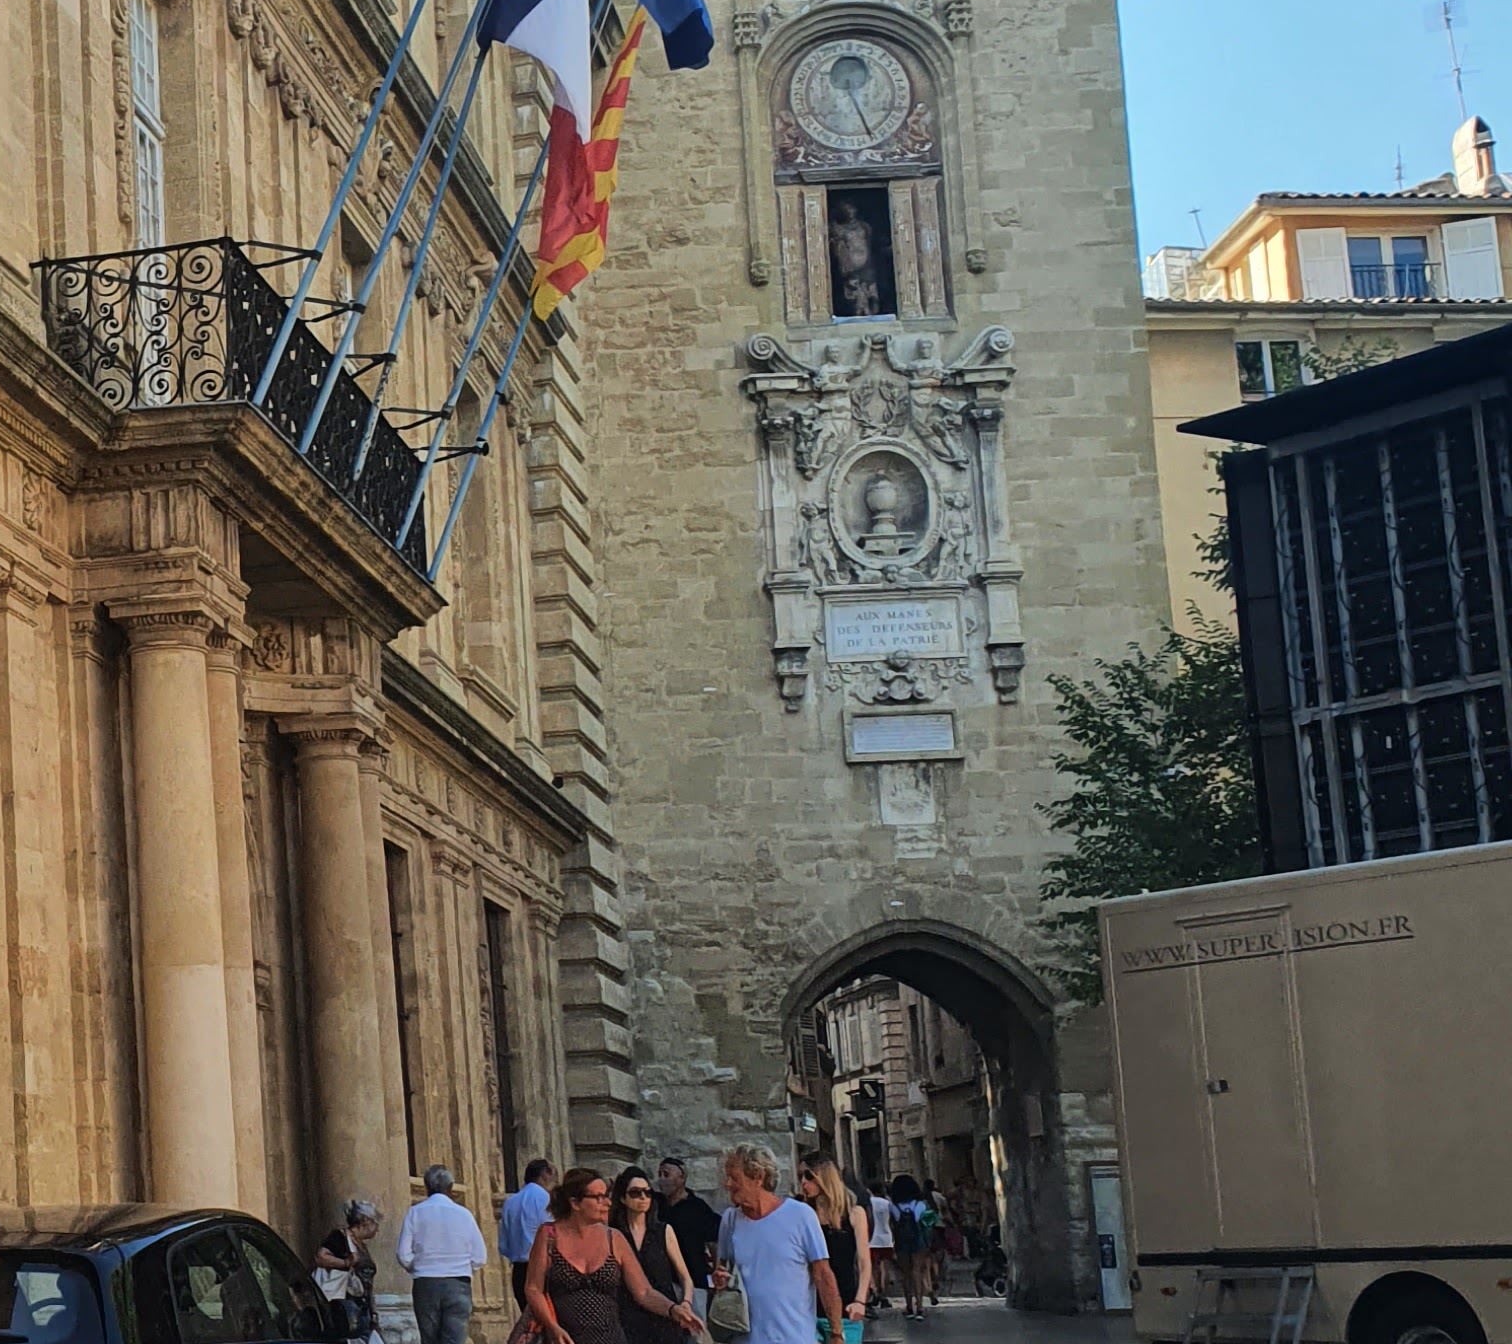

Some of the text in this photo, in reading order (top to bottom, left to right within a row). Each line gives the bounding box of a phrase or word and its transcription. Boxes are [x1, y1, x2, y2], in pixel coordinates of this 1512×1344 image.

[855, 611, 881, 621] AUX
[837, 625, 861, 635] DES
[847, 634, 940, 648] DE LA PATRIE
[1122, 915, 1413, 968] WWW.SUPERISION.FR
